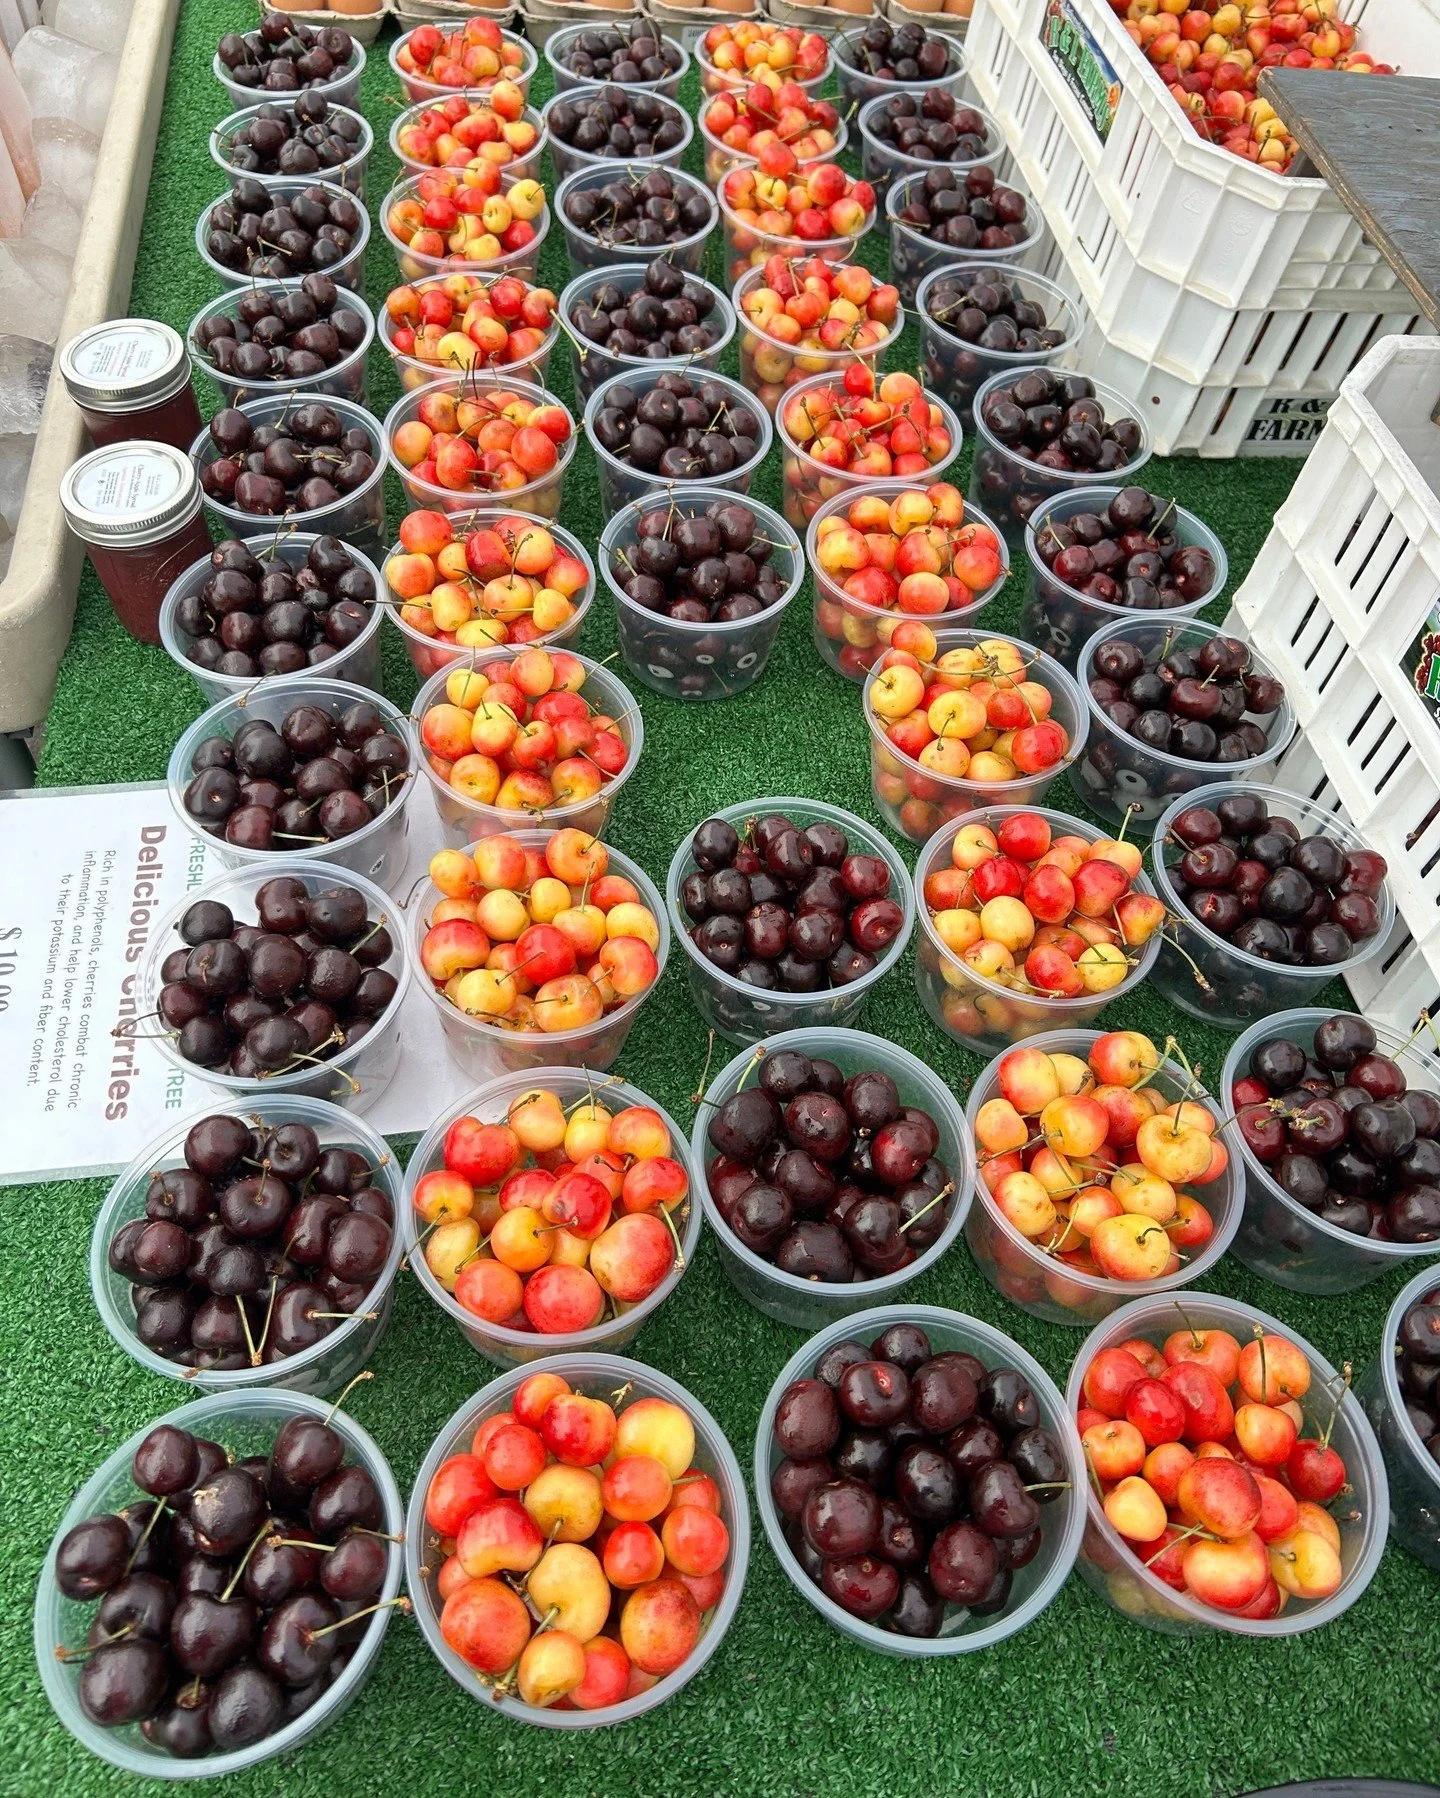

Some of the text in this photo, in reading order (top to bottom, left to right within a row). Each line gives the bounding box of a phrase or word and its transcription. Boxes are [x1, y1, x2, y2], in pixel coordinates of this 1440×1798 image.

[26, 873, 74, 1087] to their potassium and fiber content.
[45, 850, 97, 1112] inflammation, and help lower cholesterol due
[67, 849, 117, 1109] Rich in polyphenols, cherries combat chronic
[105, 825, 167, 1121] Delicious Cherries
[187, 837, 206, 891] FRESHL
